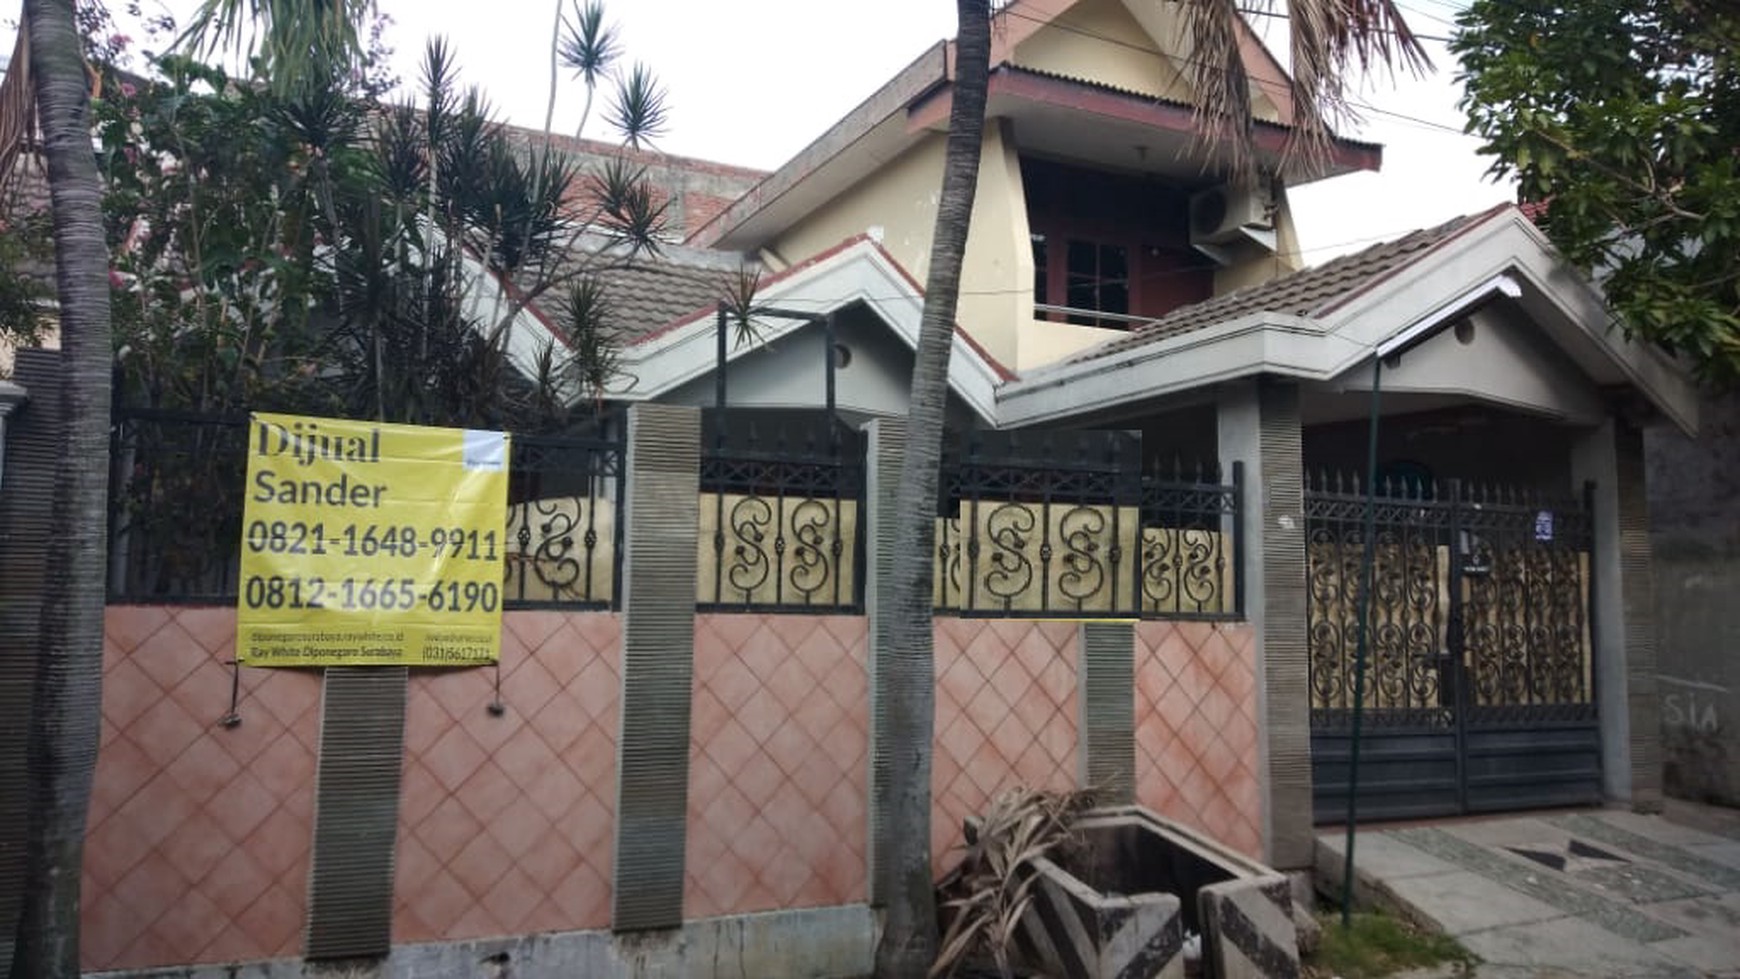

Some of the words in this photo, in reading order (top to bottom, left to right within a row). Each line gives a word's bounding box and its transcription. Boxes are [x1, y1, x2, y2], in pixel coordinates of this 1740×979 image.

[256, 421, 381, 466] Dijual
[253, 470, 388, 508] Sander
[247, 519, 498, 562] 0821-1648-9911
[245, 575, 499, 614] 0812-1665-6190
